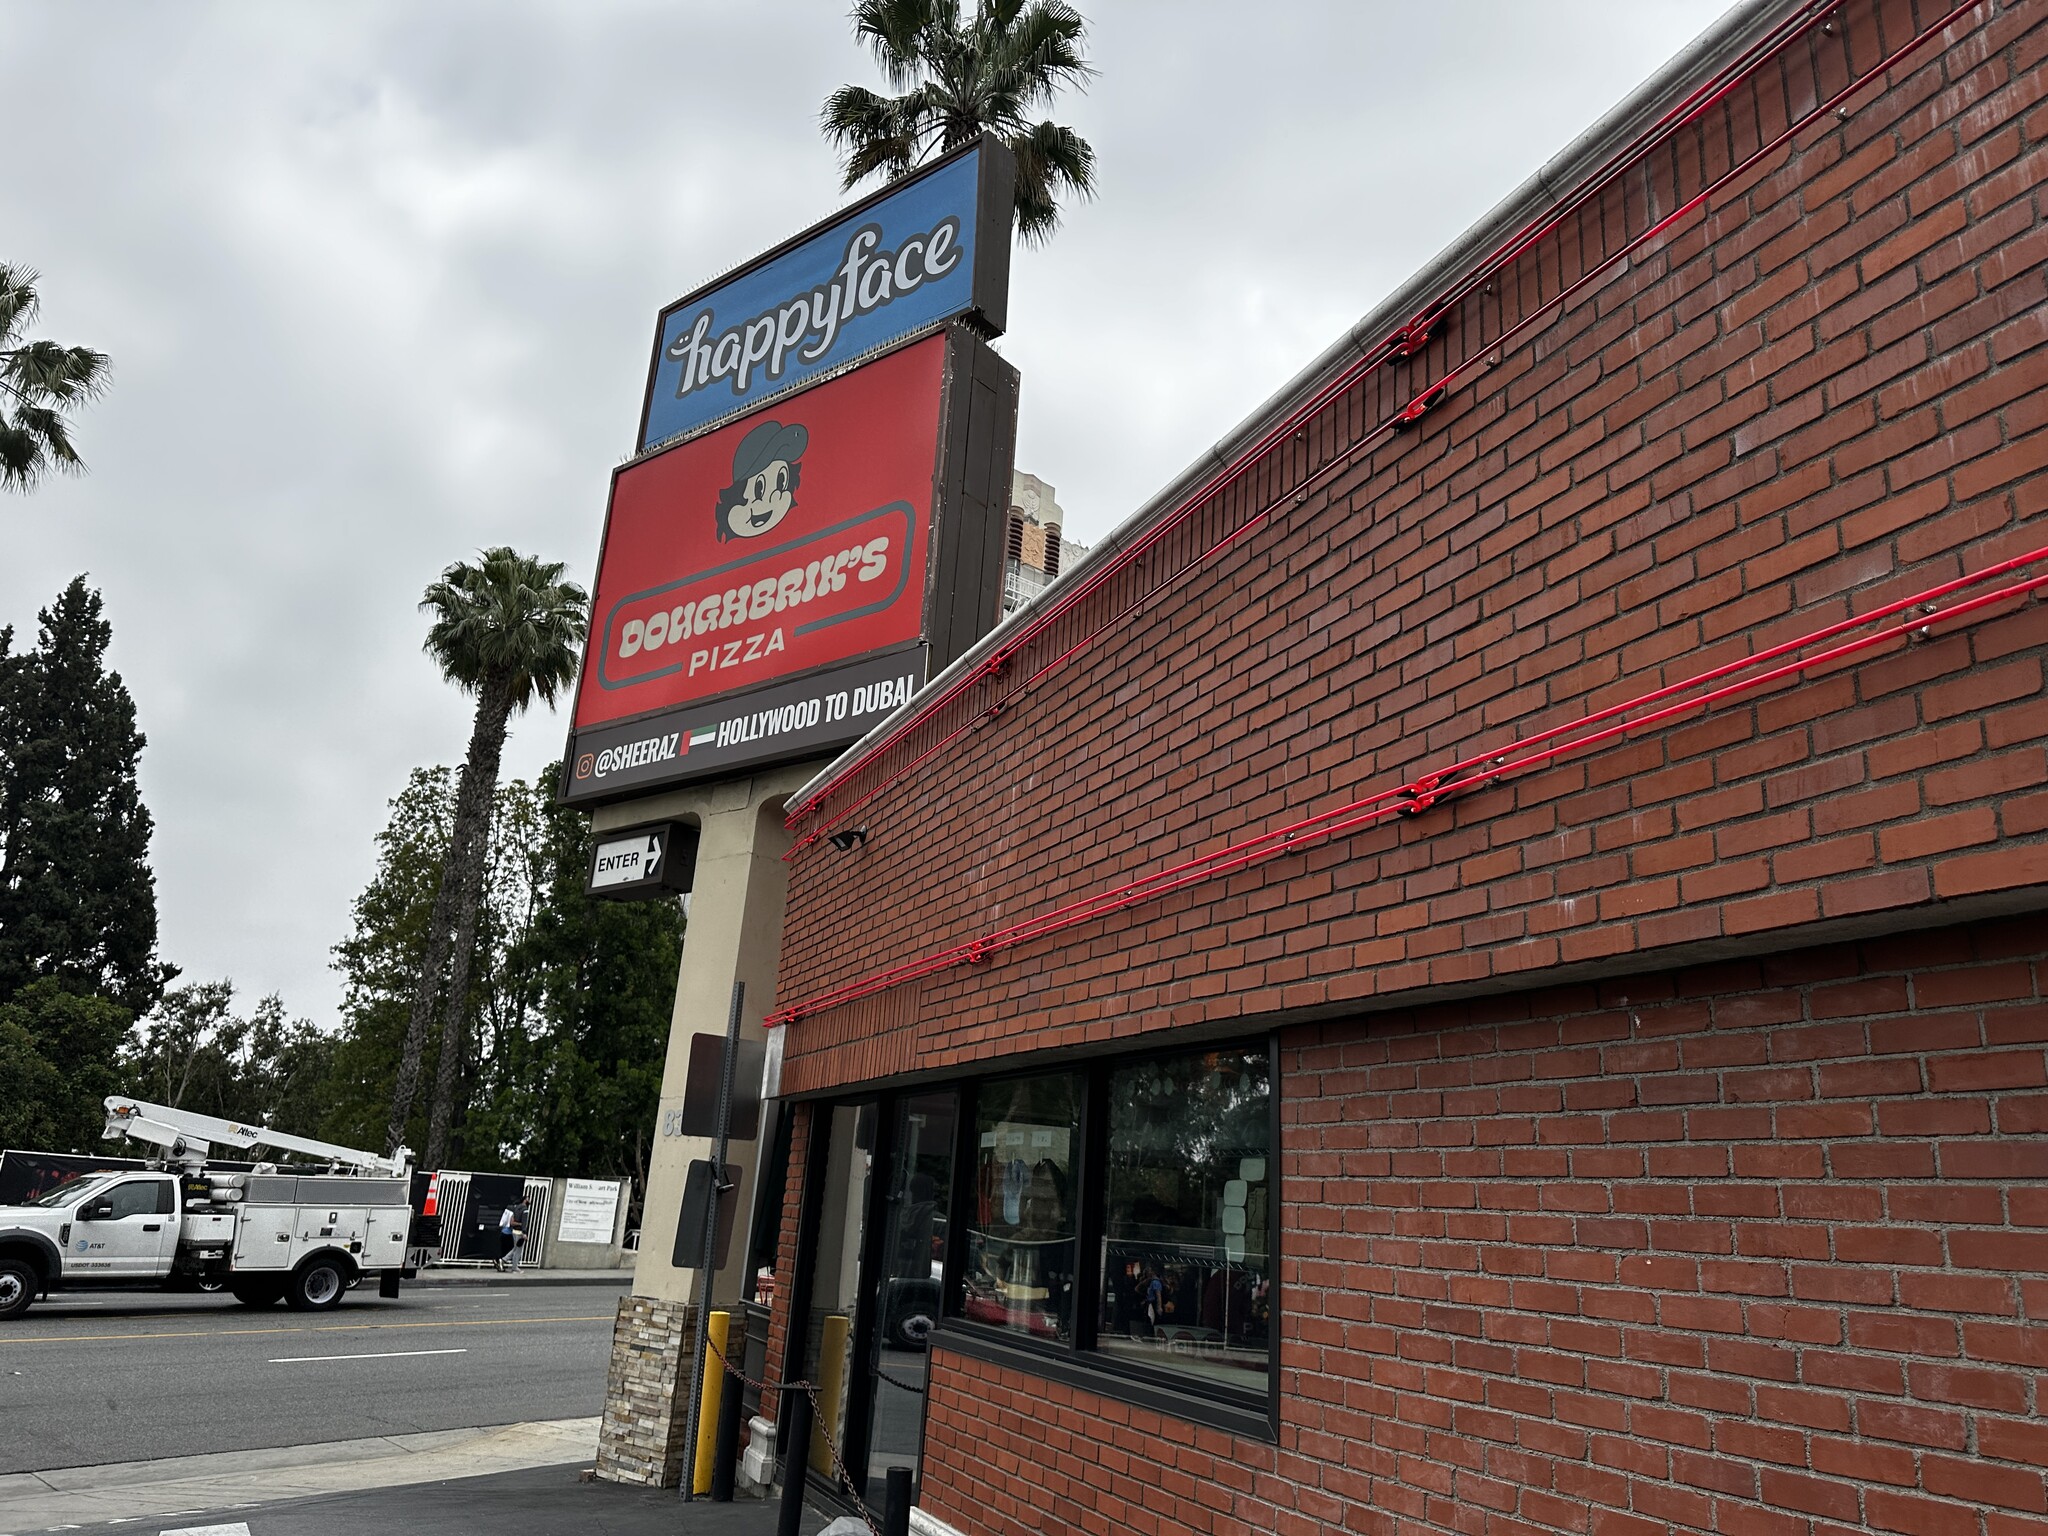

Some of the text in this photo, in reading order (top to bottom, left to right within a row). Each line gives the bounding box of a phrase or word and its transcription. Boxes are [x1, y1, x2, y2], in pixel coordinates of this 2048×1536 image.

[670, 223, 958, 394] happyface
[618, 536, 889, 659] DOUGHBRIK'S
[688, 628, 785, 677] PIZZA
[594, 673, 914, 778] @SHEERAZ HOLLYWOOD TO DUBAI
[598, 851, 640, 872] ENTER
[237, 1127, 258, 1139] Altec
